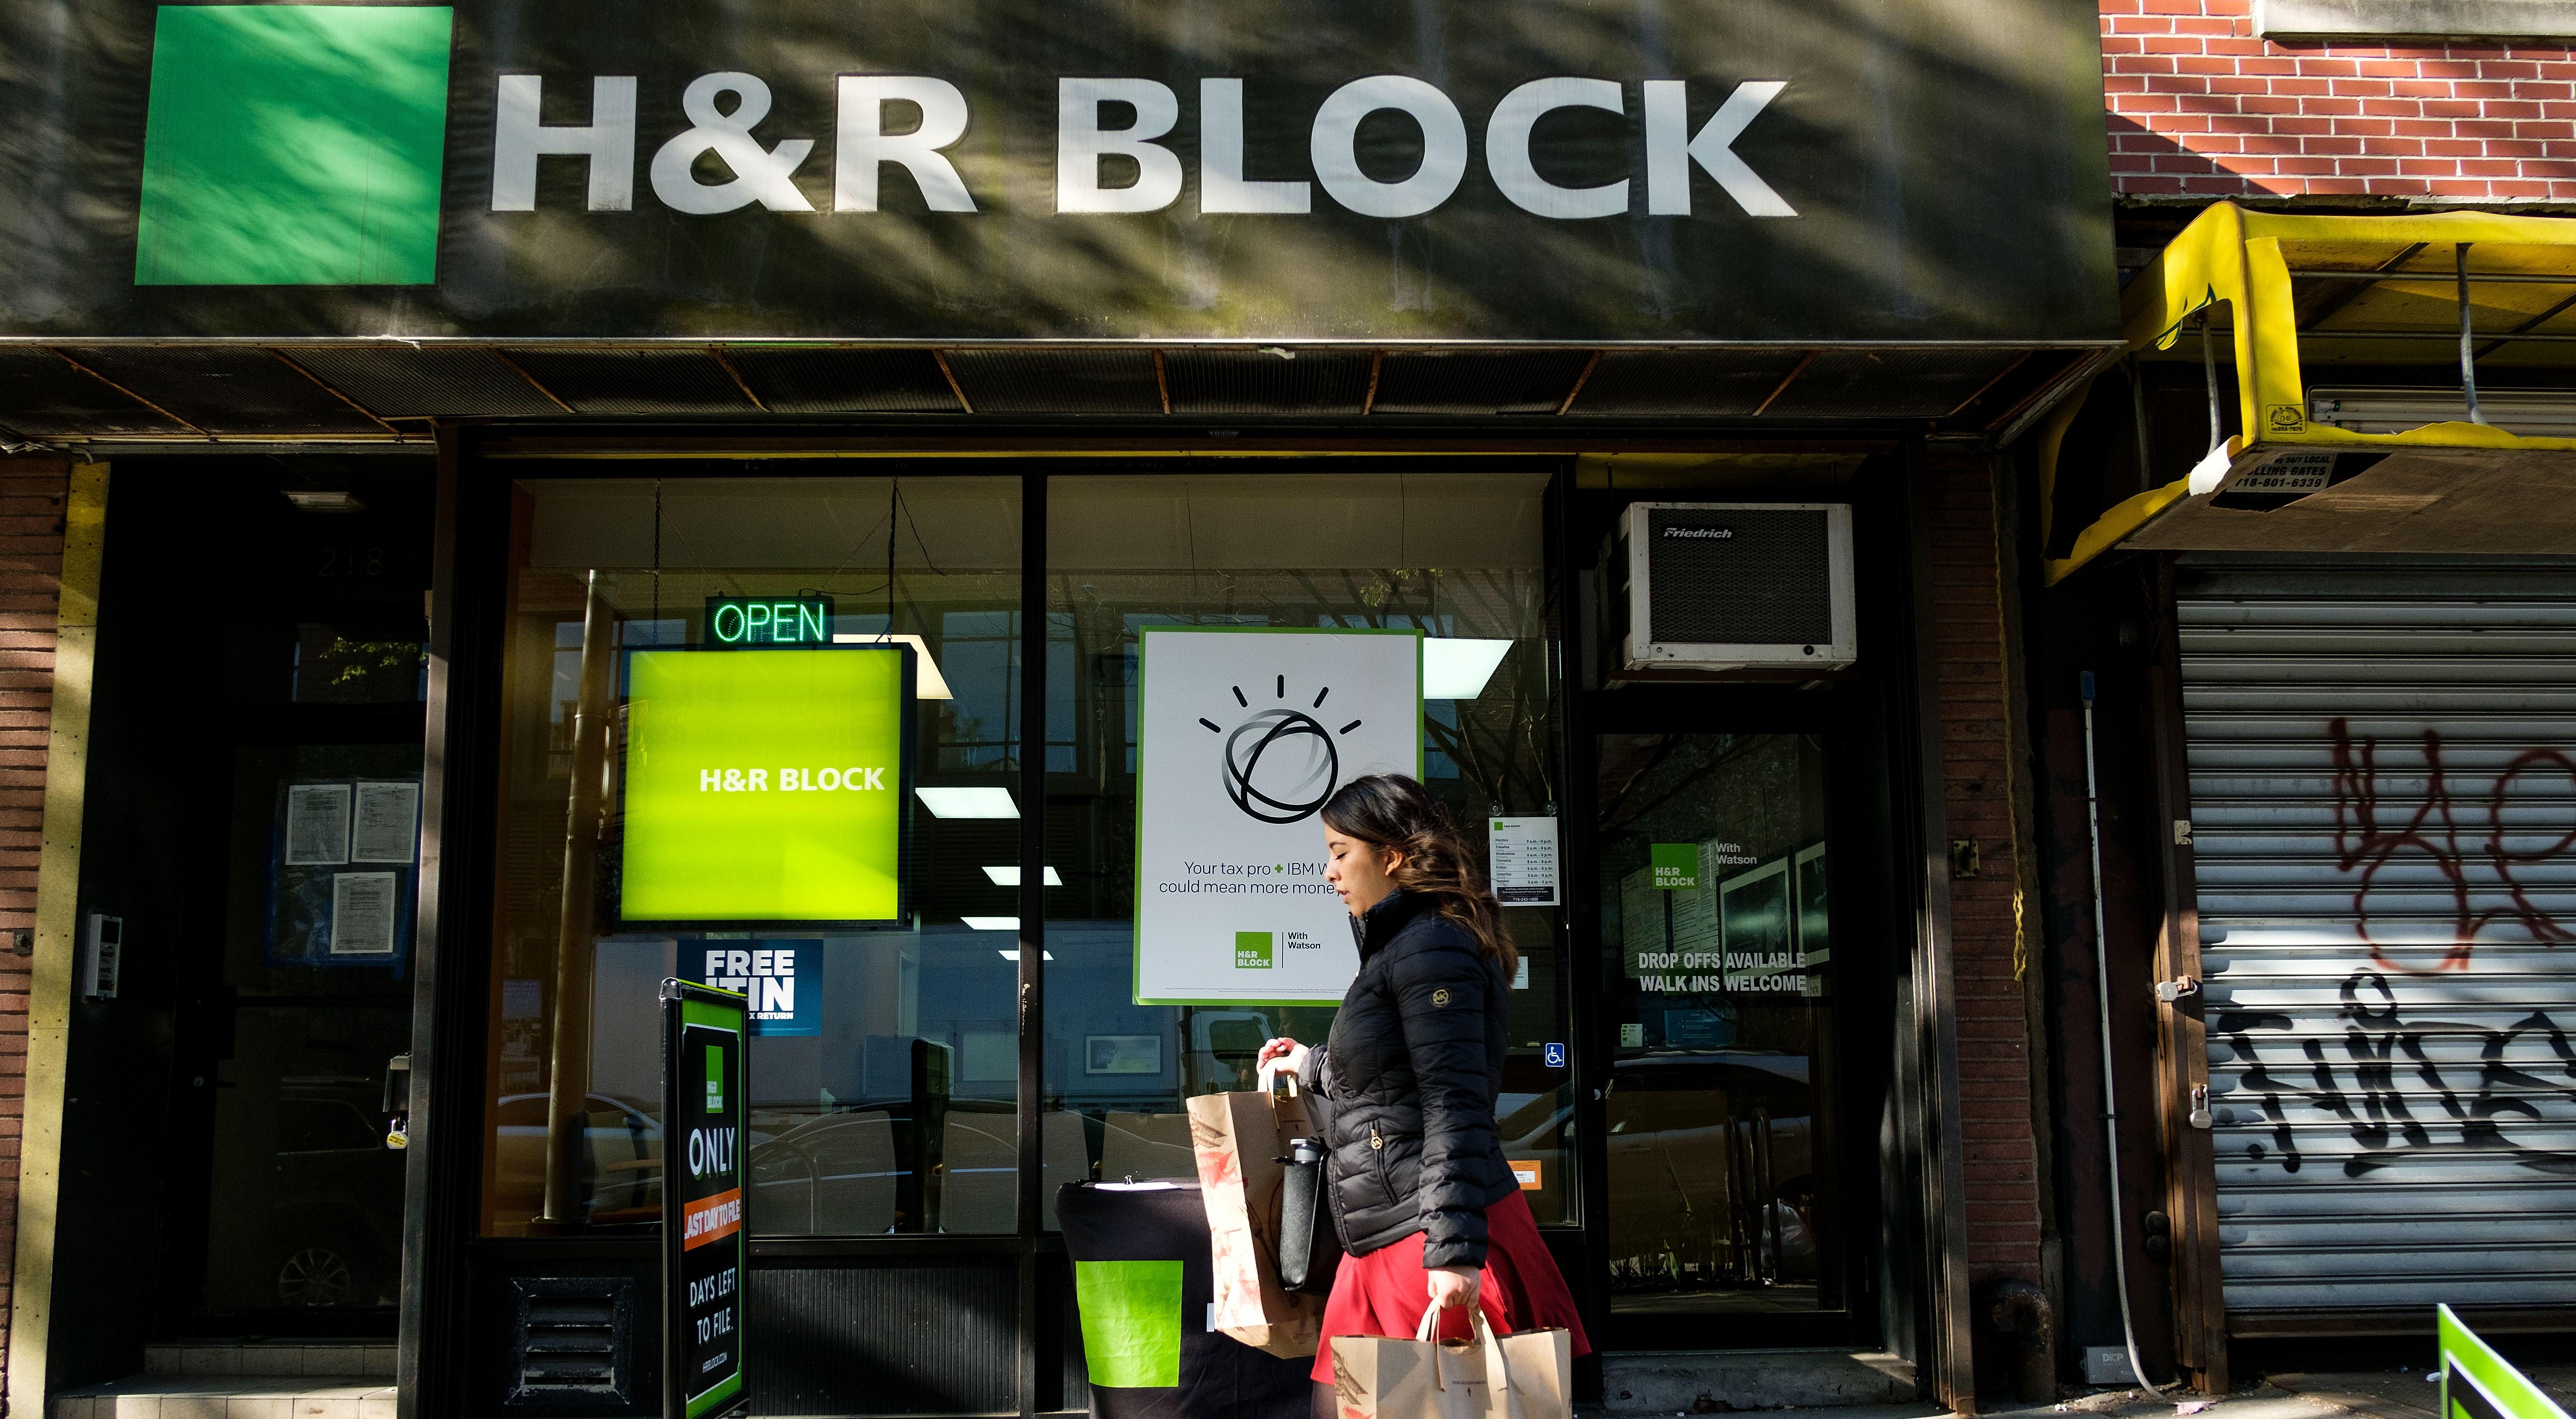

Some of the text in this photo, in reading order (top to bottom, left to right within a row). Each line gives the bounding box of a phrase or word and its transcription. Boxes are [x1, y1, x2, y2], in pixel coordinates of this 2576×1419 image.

[490, 73, 1798, 217] H&R BLOCK
[2248, 466, 2327, 475] LLING GATES
[1663, 528, 1732, 538] Friedrich
[318, 547, 383, 577] 218
[715, 604, 825, 642] OPEN
[700, 767, 885, 792] H&R BLOCK
[1716, 843, 1741, 852] With
[1716, 855, 1757, 864] Watson
[1184, 861, 1217, 875] Your
[1221, 863, 1243, 875] tax
[1247, 865, 1271, 878] pro
[1288, 863, 1314, 875] IBM
[1655, 867, 1680, 876] H&R
[1159, 879, 1200, 893] could
[1204, 883, 1246, 894] mean
[1251, 883, 1288, 894] more
[1655, 877, 1695, 886] BLOCK
[1288, 932, 1308, 940] With
[1288, 941, 1321, 949] Watson
[706, 950, 795, 976] FREE
[1237, 958, 1270, 966] BLOCK
[1638, 952, 1806, 969] DROP OFFS AVAILABLE
[1640, 975, 1807, 991] WALK INS WELCOME
[705, 977, 795, 1012] TIN
[689, 1127, 735, 1176] ONLY
[704, 1206, 719, 1233] DAY
[719, 1203, 728, 1227] TO
[728, 1199, 740, 1224] FILE
[690, 1267, 735, 1308] DAYS LEFT
[697, 1307, 733, 1345] TO FILE.
